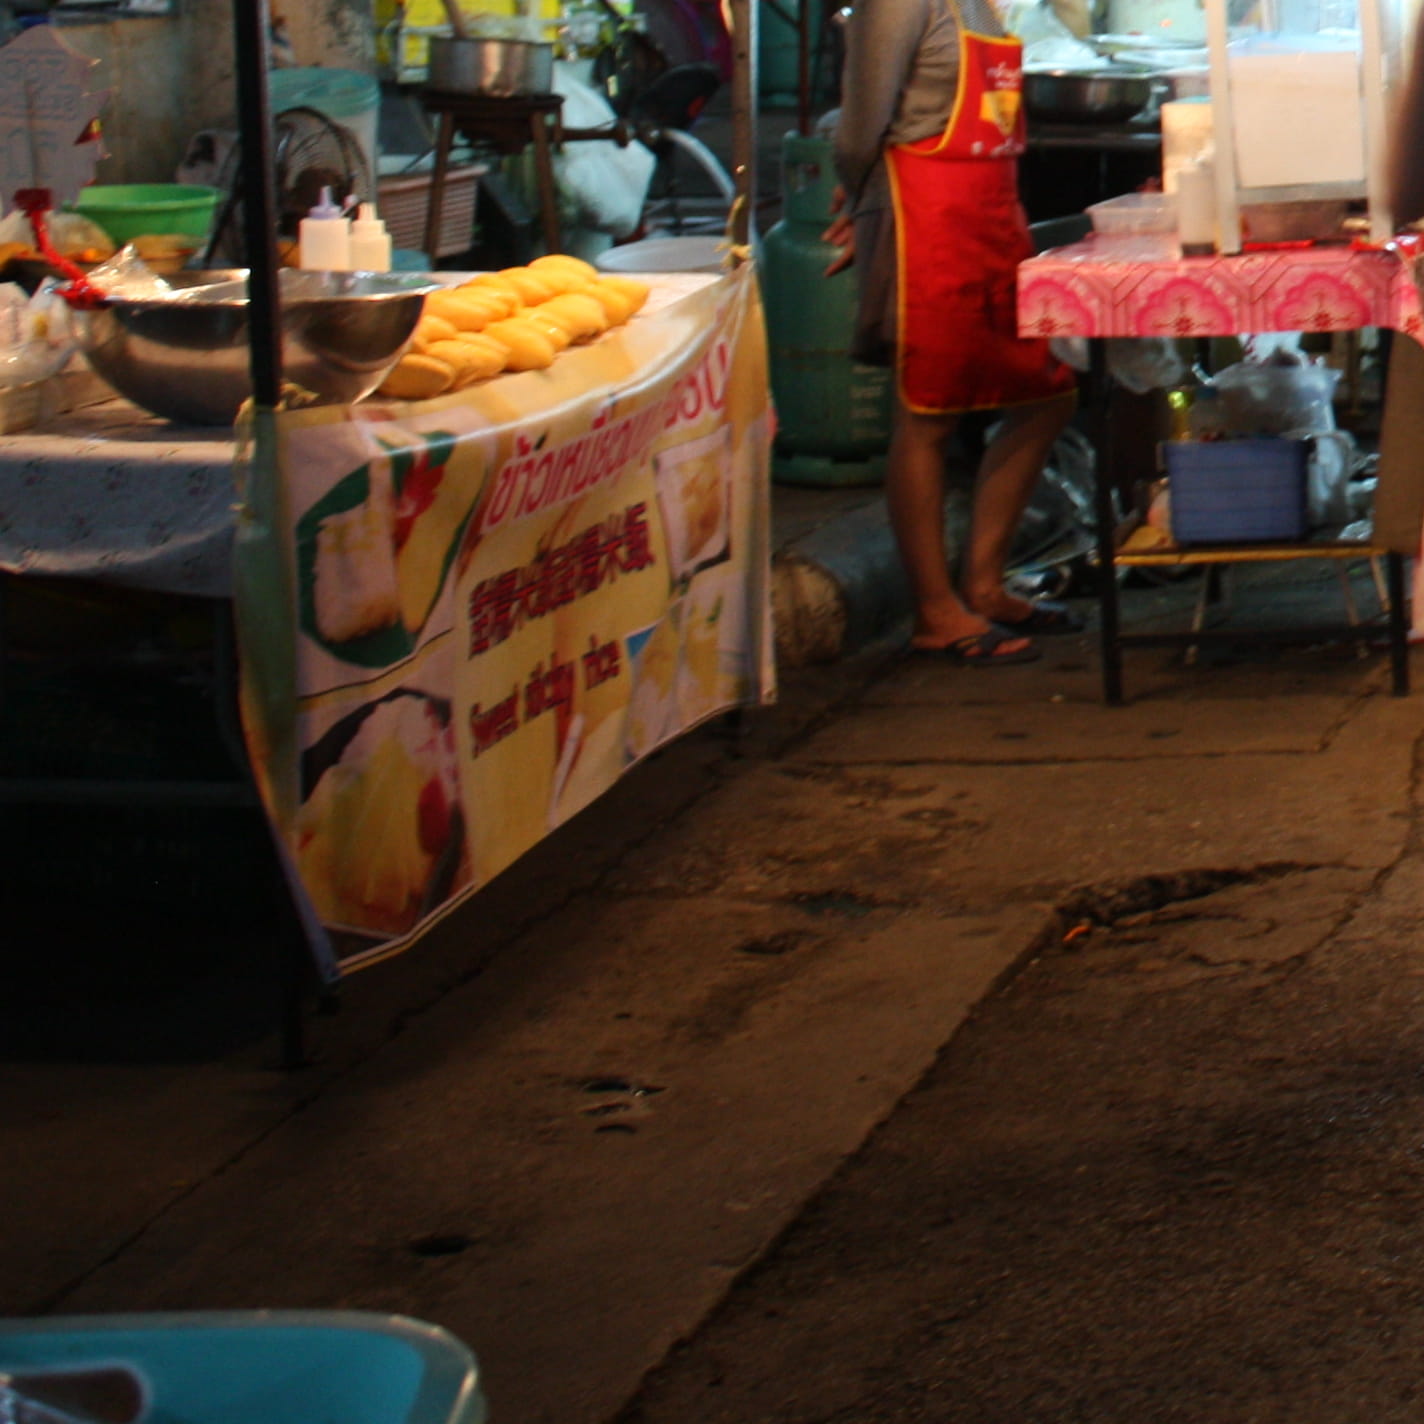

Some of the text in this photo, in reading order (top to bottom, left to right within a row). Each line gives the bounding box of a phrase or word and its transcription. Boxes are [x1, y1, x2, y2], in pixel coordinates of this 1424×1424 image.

[469, 633, 620, 760] Sweet sticky rice
